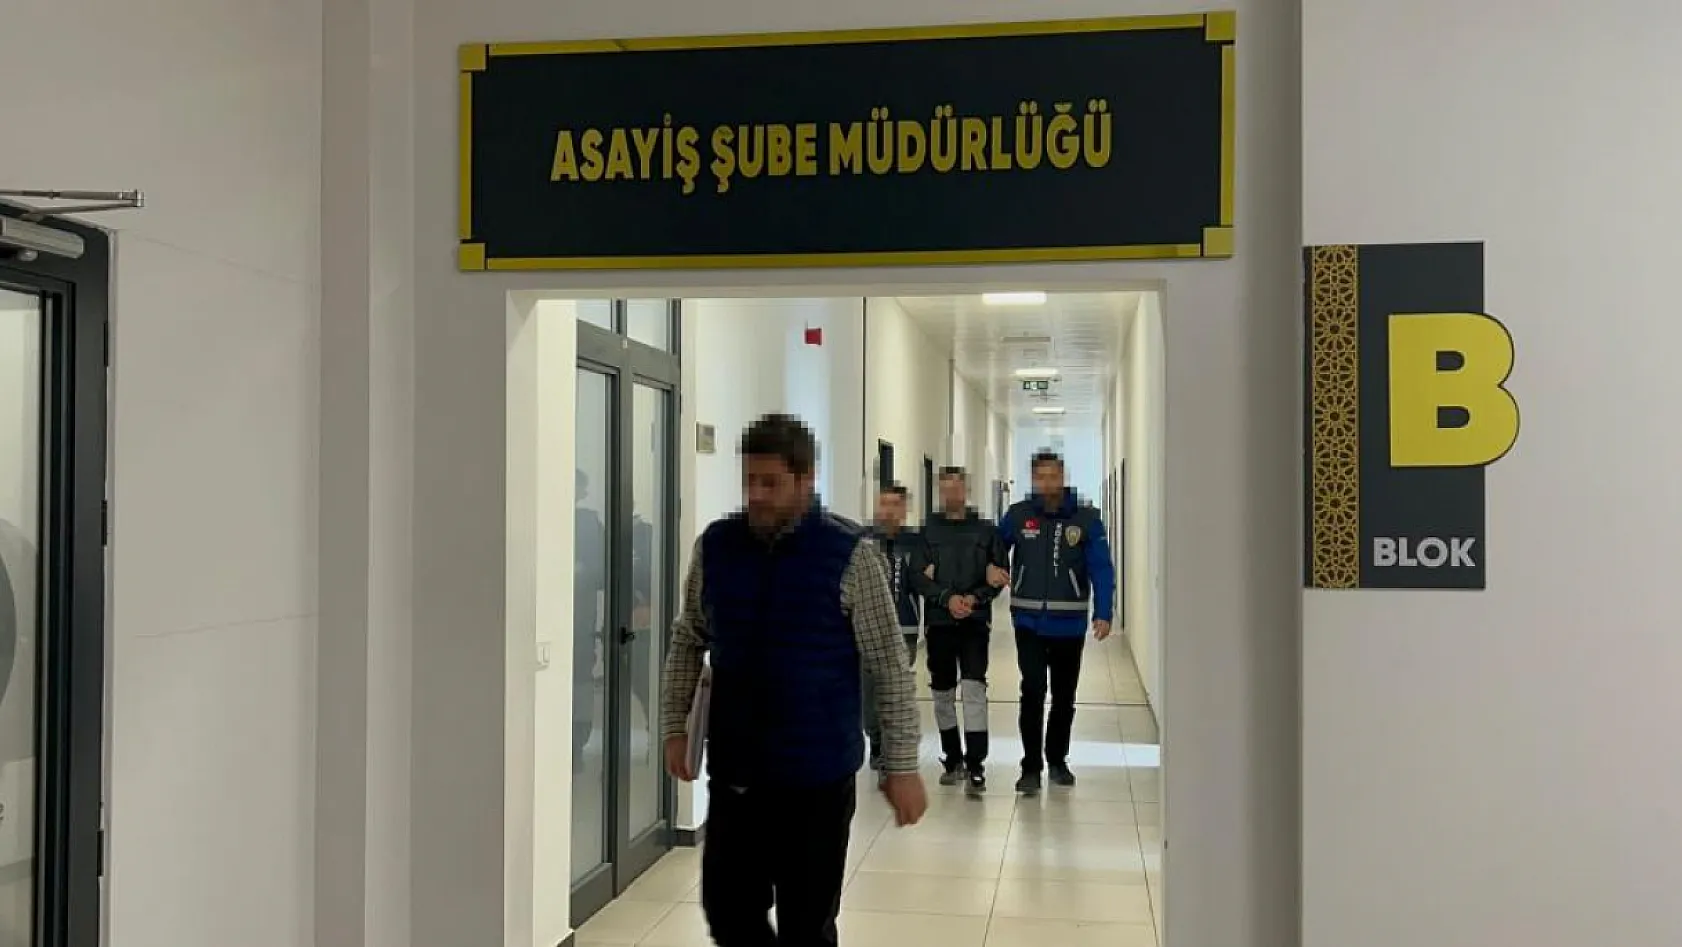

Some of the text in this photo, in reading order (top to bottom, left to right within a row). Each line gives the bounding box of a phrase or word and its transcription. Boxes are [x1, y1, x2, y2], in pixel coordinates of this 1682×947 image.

[551, 98, 1113, 194] ASAYİŞ ŞUBE MÜDÜRLÜĞÜ
[1388, 312, 1520, 467] B
[1373, 537, 1476, 567] BLOK
